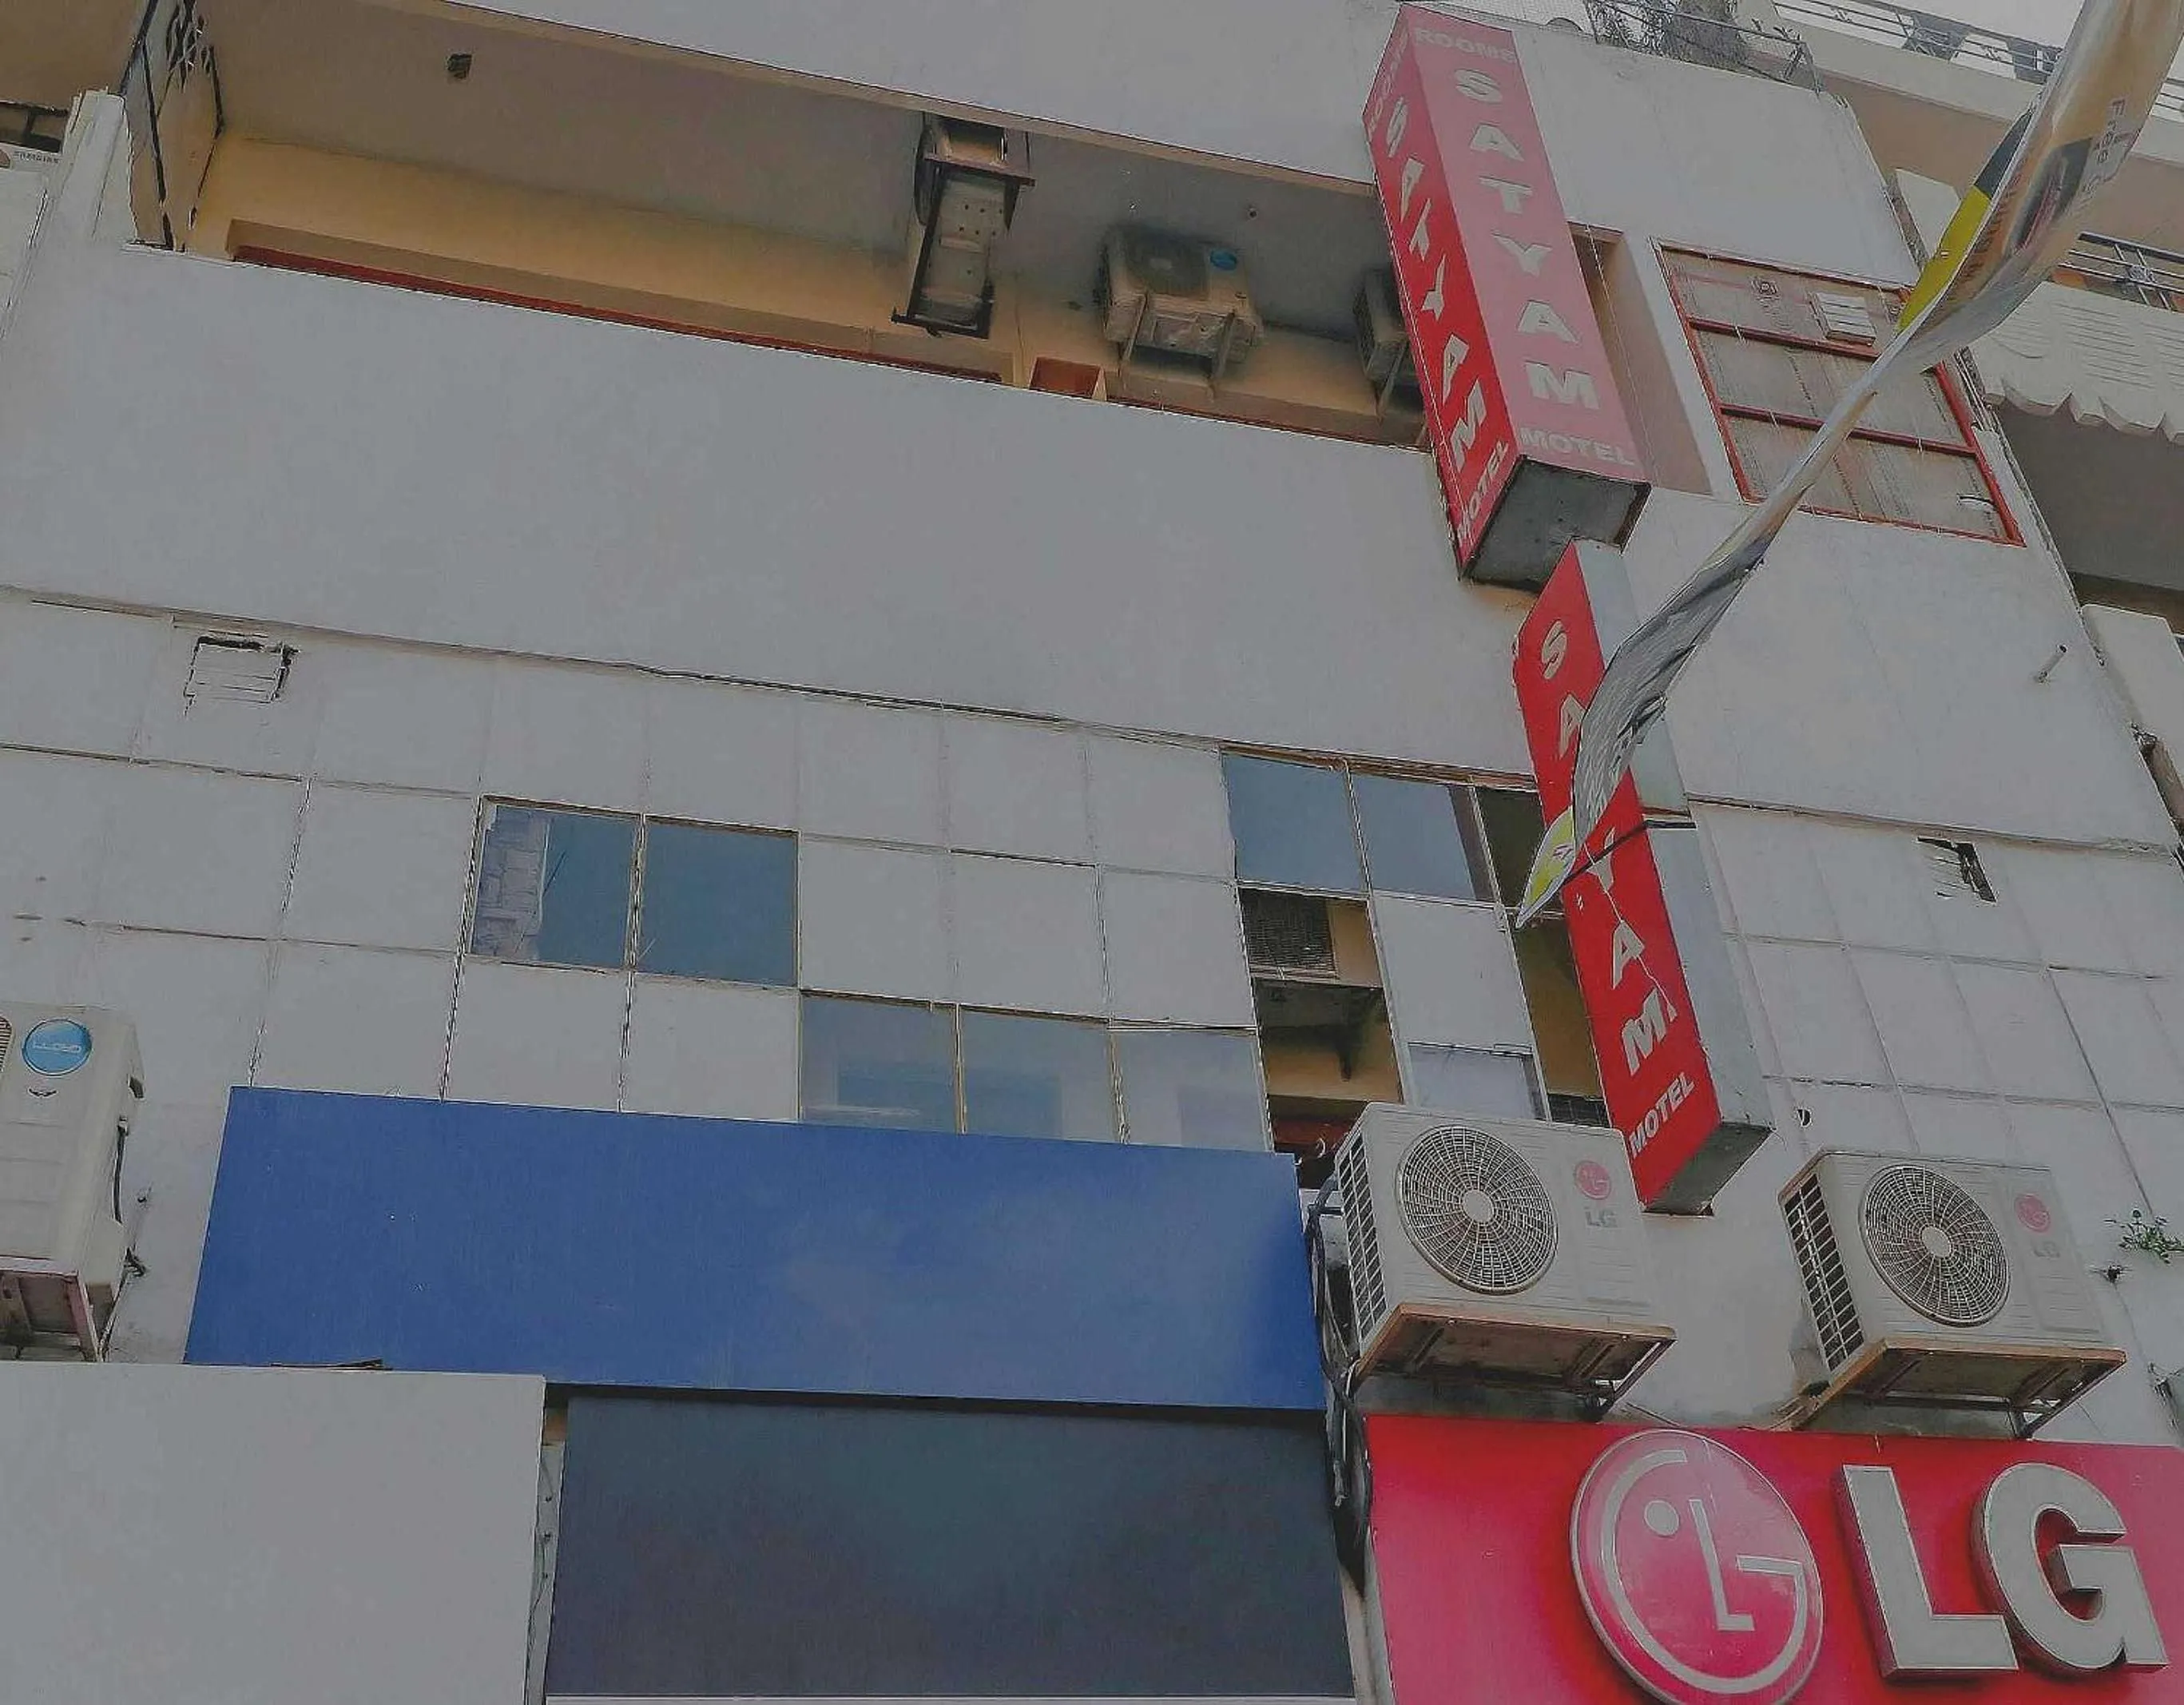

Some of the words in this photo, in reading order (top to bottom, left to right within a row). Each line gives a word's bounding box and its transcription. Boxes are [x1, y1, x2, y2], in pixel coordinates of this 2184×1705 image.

[1413, 26, 1518, 64] ROOMS
[1386, 95, 1487, 471] SATYAM
[1455, 68, 1599, 409] SATYAM
[1456, 439, 1509, 548] MOTEL
[1519, 426, 1636, 467] MOTEL
[1540, 618, 1677, 1076] SAYAM
[1628, 1071, 1695, 1159] MOTEL
[1584, 1206, 1618, 1227] LG
[1835, 1463, 2168, 1678] LG
